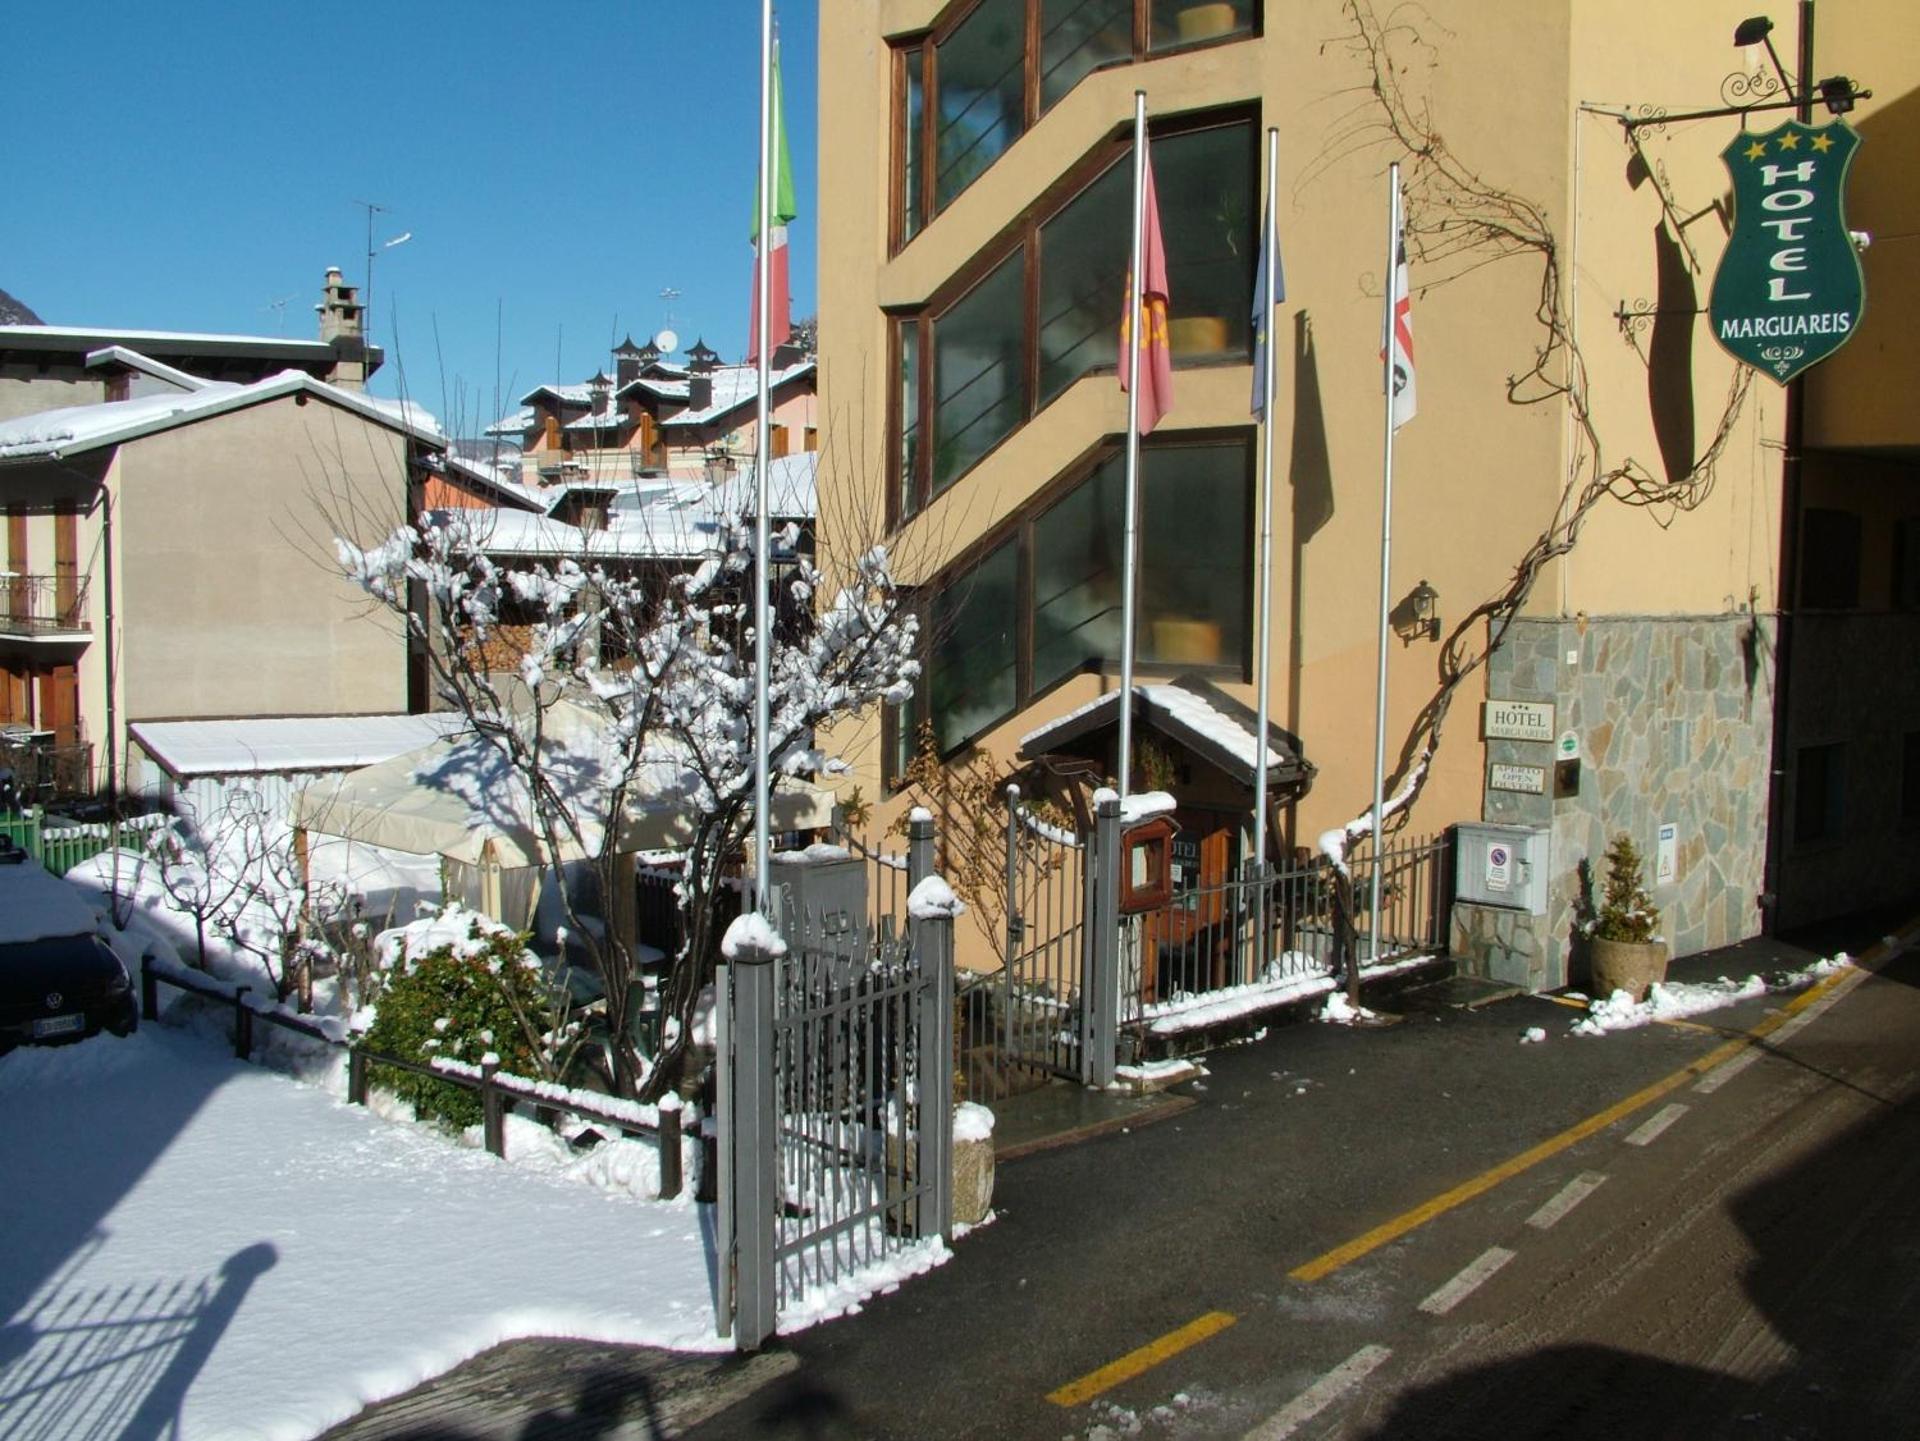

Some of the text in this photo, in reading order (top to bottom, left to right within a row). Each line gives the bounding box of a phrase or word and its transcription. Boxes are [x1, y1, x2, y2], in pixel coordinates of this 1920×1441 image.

[1760, 160, 1816, 301] HOTEL
[1720, 311, 1850, 339] MARGUAREIS
[1494, 710, 1546, 728] HOTEL
